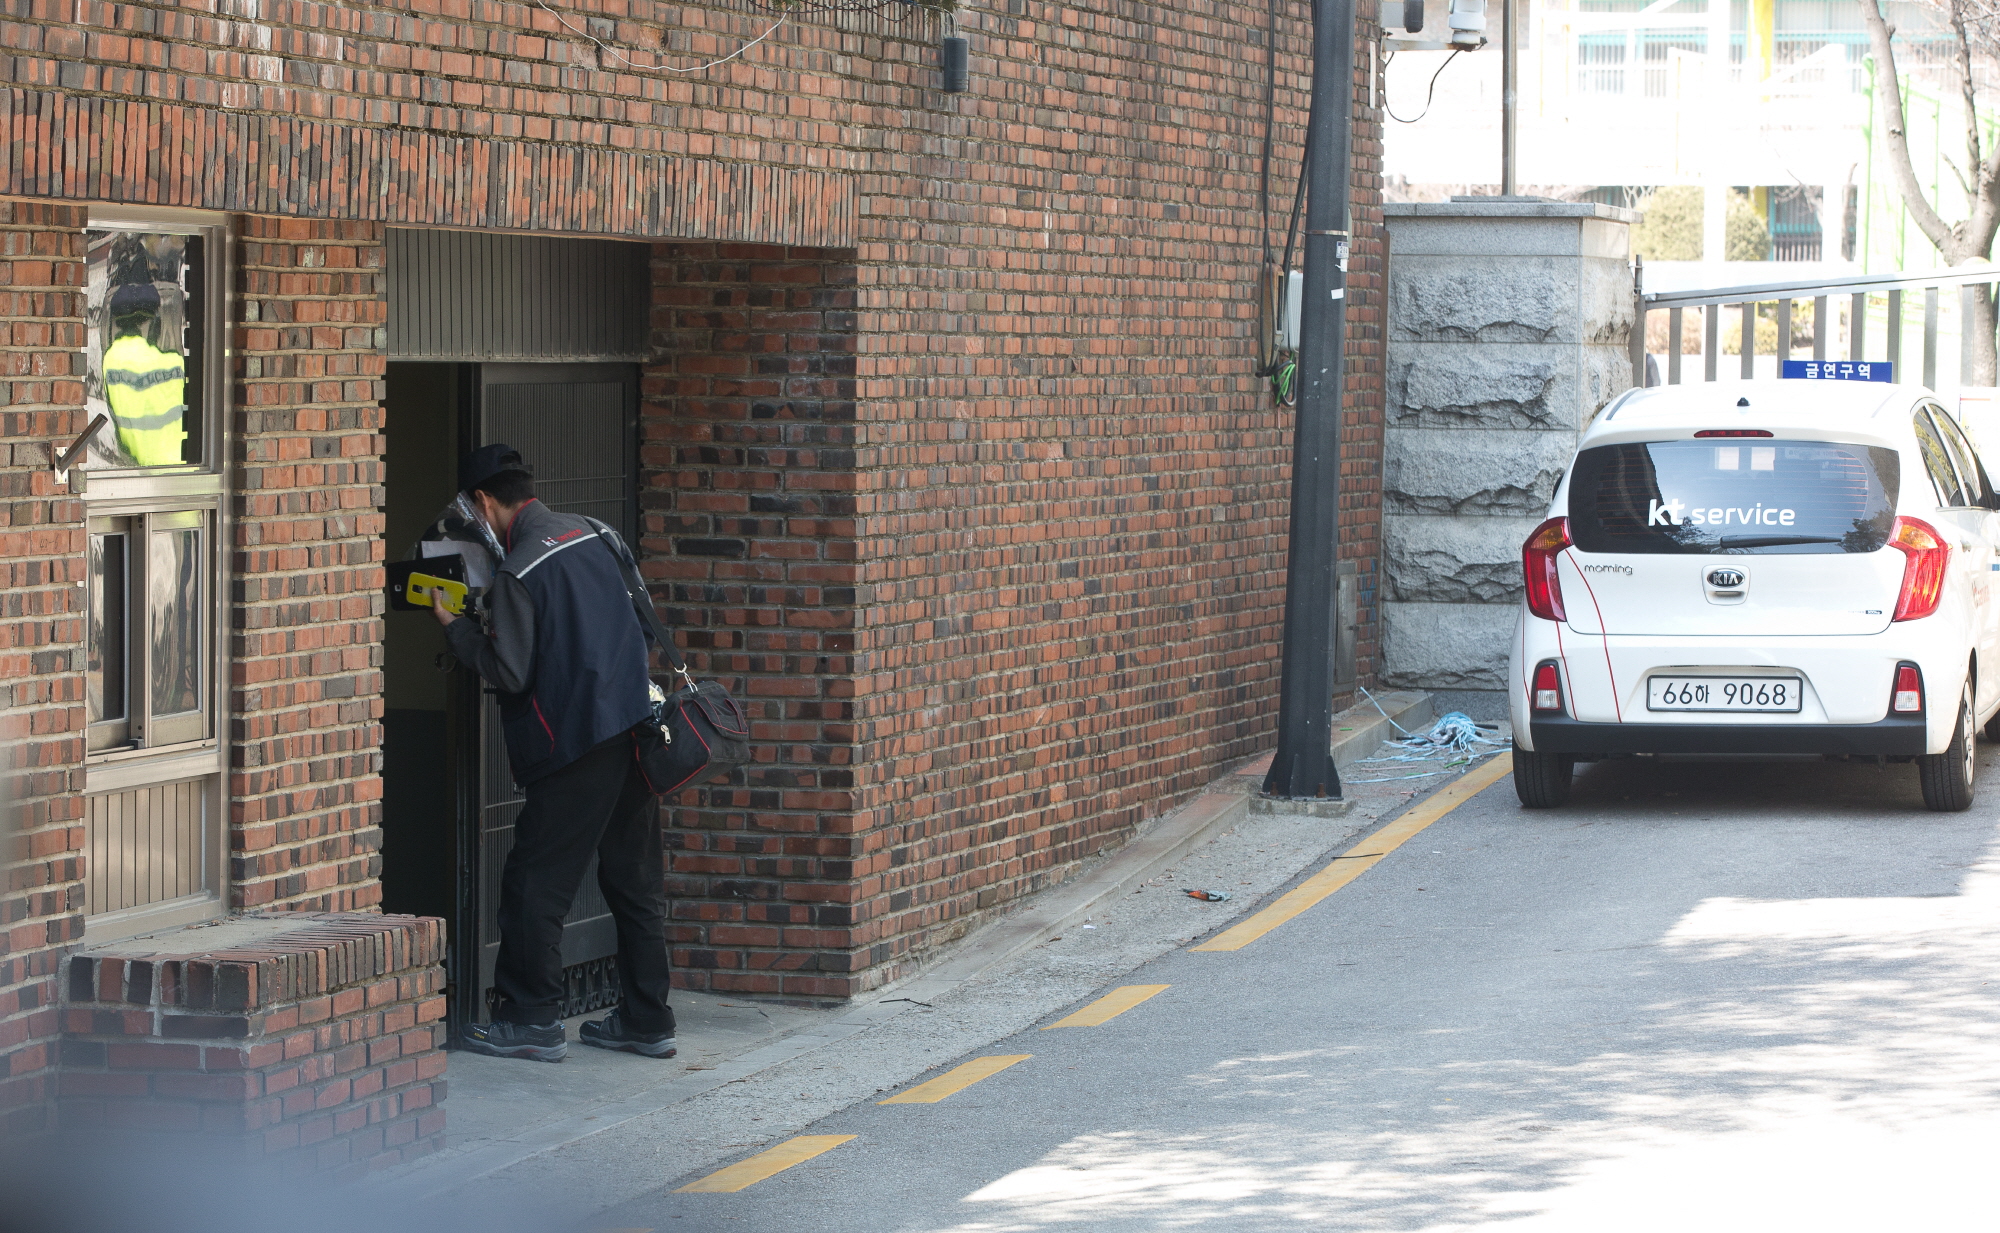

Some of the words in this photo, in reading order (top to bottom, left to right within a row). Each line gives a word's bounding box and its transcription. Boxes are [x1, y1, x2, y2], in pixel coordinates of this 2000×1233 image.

[1805, 363, 1871, 380] 금연구역
[1648, 498, 1685, 527] kt
[1691, 502, 1796, 526] service
[541, 536, 559, 547] kt
[1584, 563, 1634, 576] morning
[1713, 573, 1739, 585] KIA
[1662, 682, 1710, 705] 66하
[1723, 682, 1787, 706] 9068
